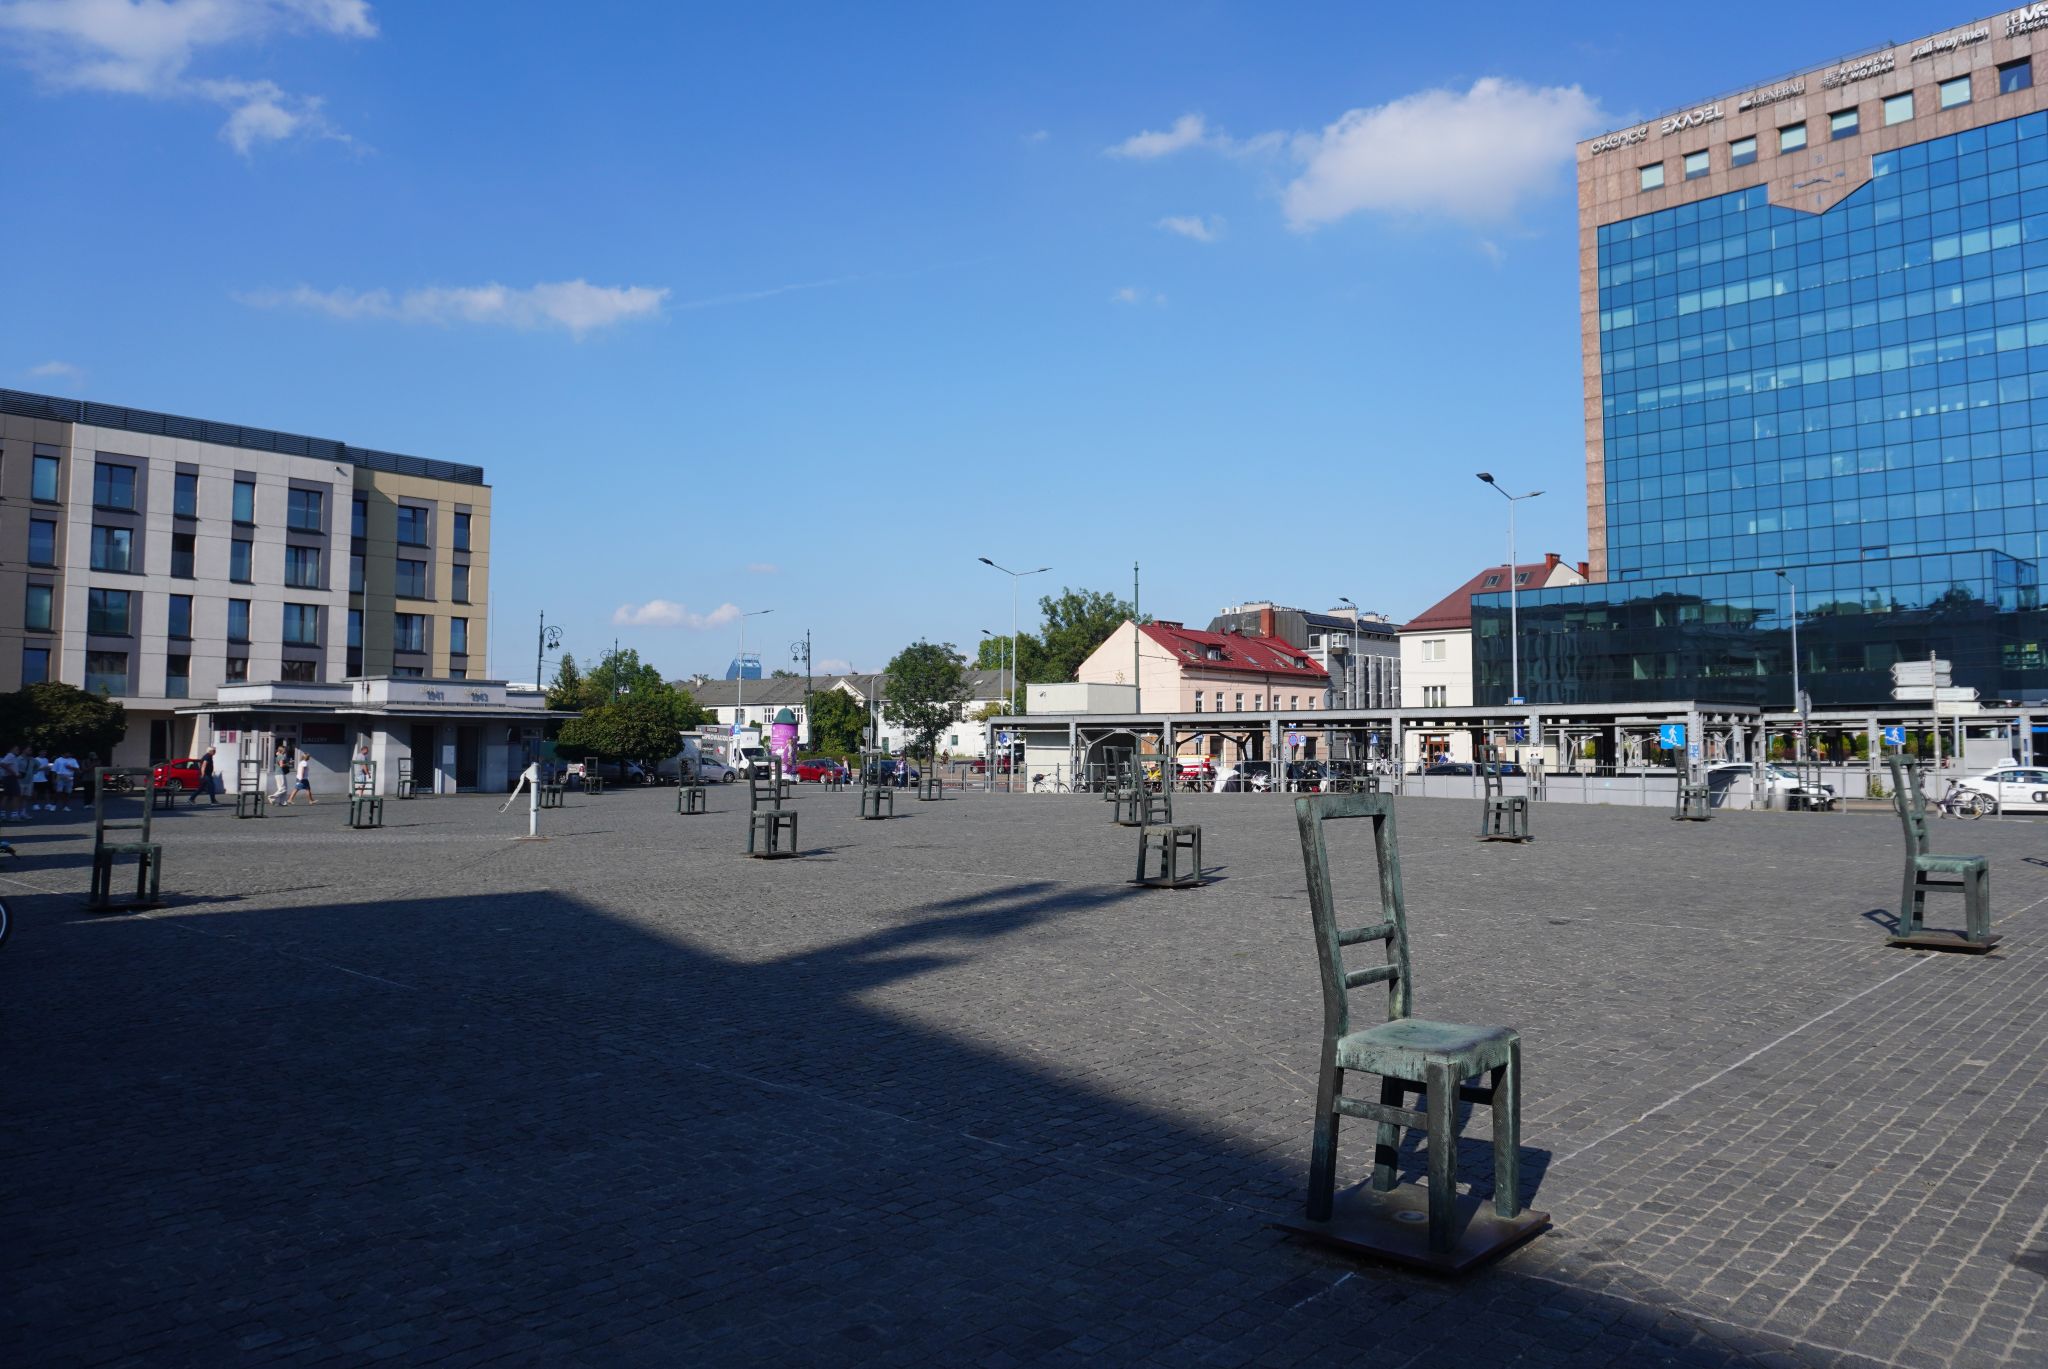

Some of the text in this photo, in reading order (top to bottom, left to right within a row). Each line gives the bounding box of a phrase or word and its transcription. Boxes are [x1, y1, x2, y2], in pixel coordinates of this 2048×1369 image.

[1839, 51, 1894, 75] KASPRZYK
[1850, 59, 1895, 79] WOJDAN
[1753, 80, 1805, 104] GENERALI
